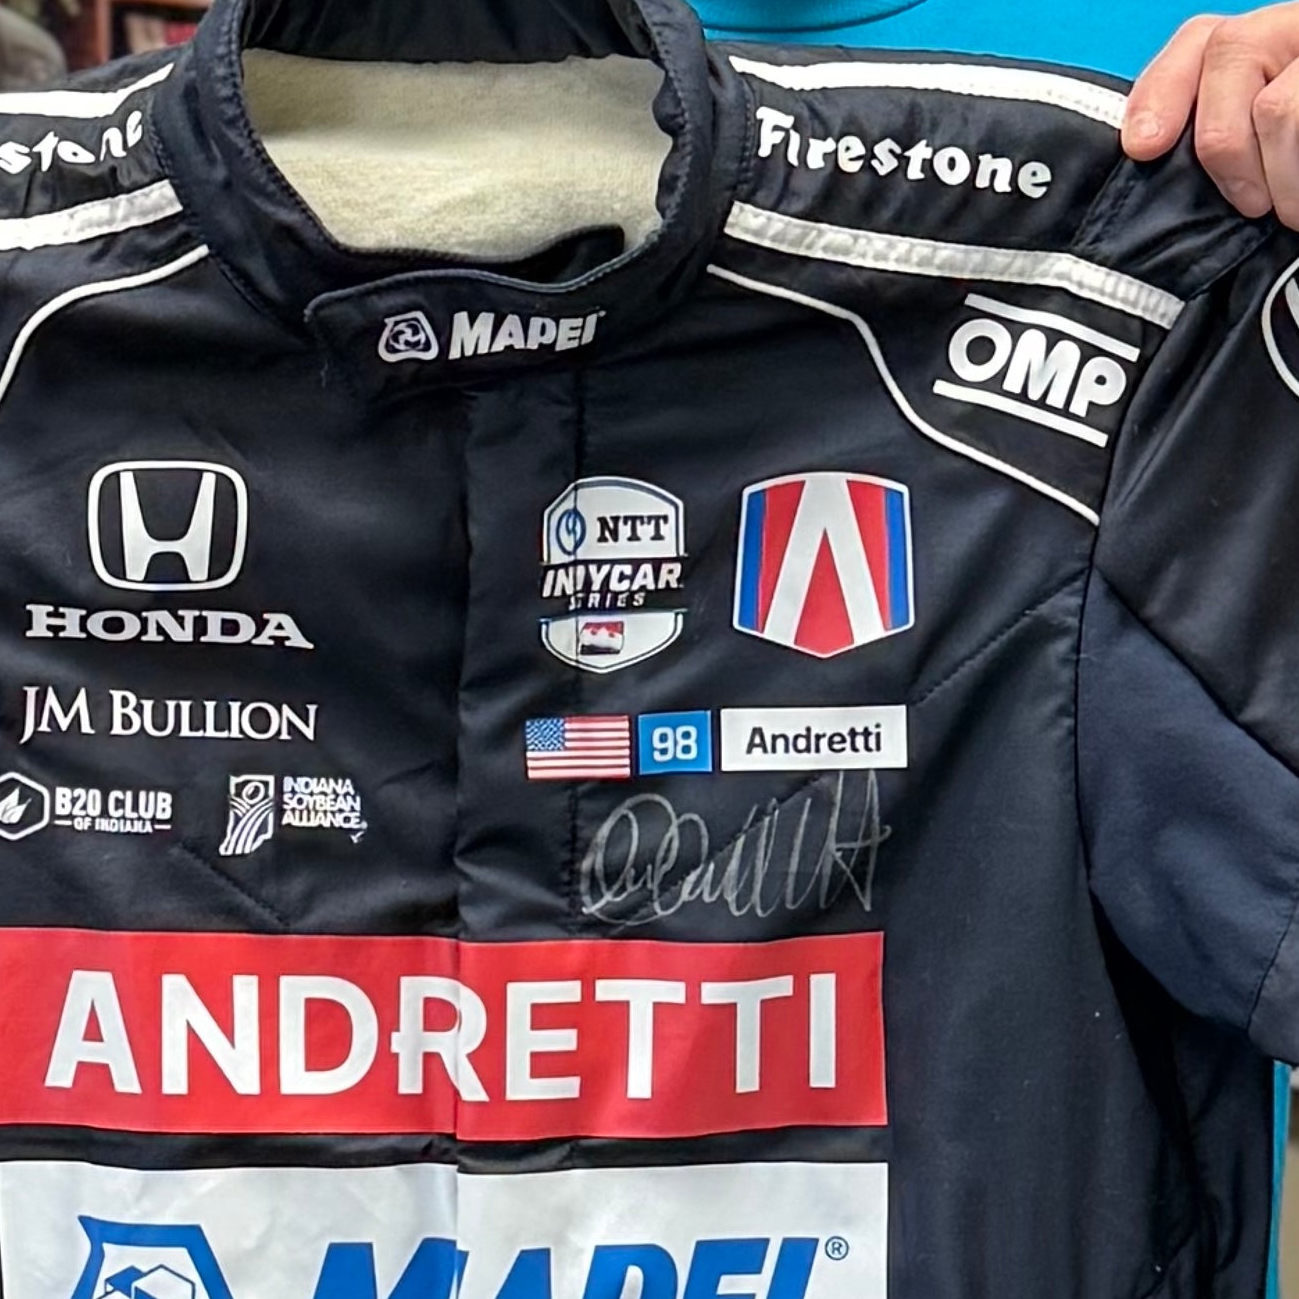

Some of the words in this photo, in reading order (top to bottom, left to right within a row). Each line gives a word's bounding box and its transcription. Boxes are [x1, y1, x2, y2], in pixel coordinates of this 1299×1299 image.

[753, 105, 1054, 200] Firestone
[447, 309, 600, 361] MAPEI
[946, 316, 1128, 419] OMP
[595, 515, 669, 543] NTT
[568, 591, 646, 610] SRIES
[25, 603, 314, 649] HONDA
[19, 685, 95, 745] JM
[651, 725, 699, 762] 98
[745, 723, 883, 755] Andretti
[282, 776, 355, 795] INDIANA
[282, 793, 362, 811] SOYBEAN
[54, 787, 101, 817] B20
[107, 788, 173, 821] CLUB
[281, 810, 363, 829] ALLIANCE
[72, 818, 92, 831] OF
[94, 819, 153, 833] INDIANA
[43, 968, 839, 1103] ANDRETTI
